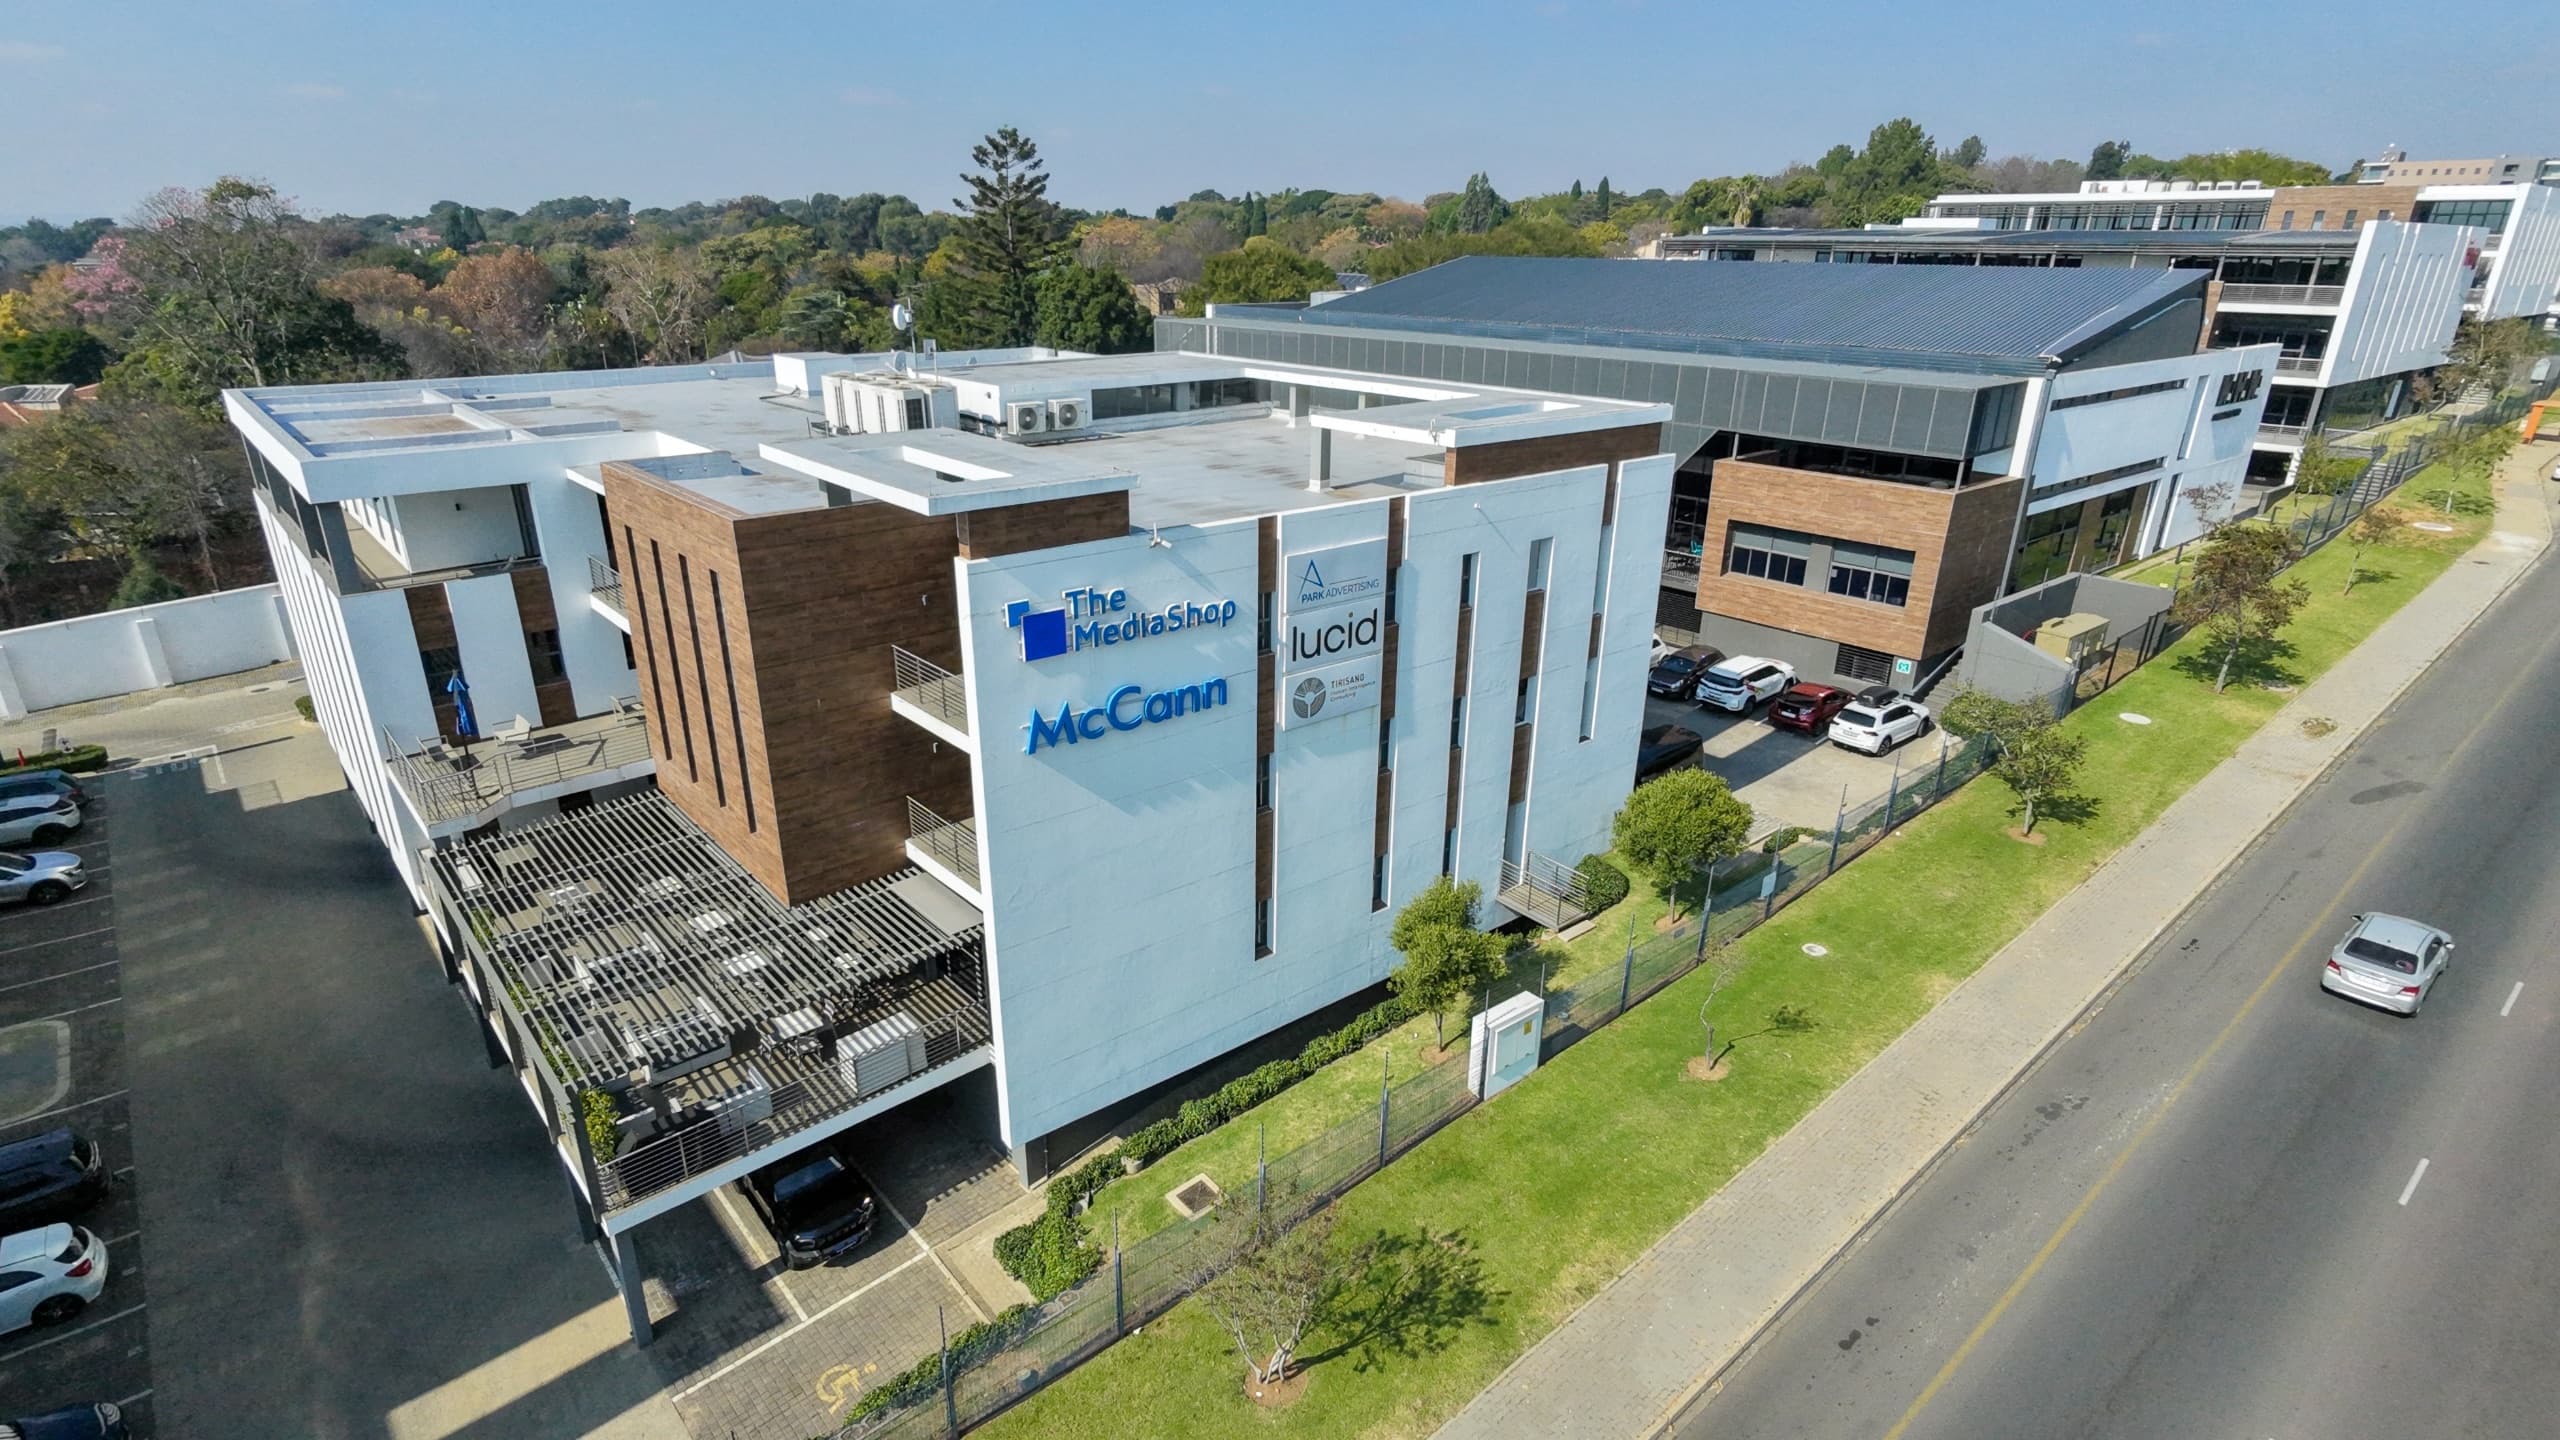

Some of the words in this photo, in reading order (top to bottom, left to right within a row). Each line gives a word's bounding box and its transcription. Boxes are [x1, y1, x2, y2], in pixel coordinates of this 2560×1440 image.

[1062, 586, 1126, 619] The
[1301, 590, 1325, 604] PARK
[1326, 579, 1380, 598] ADVERTISING
[1073, 600, 1236, 652] MediaShop
[1292, 608, 1378, 662] lucid
[1025, 677, 1228, 755] McCann
